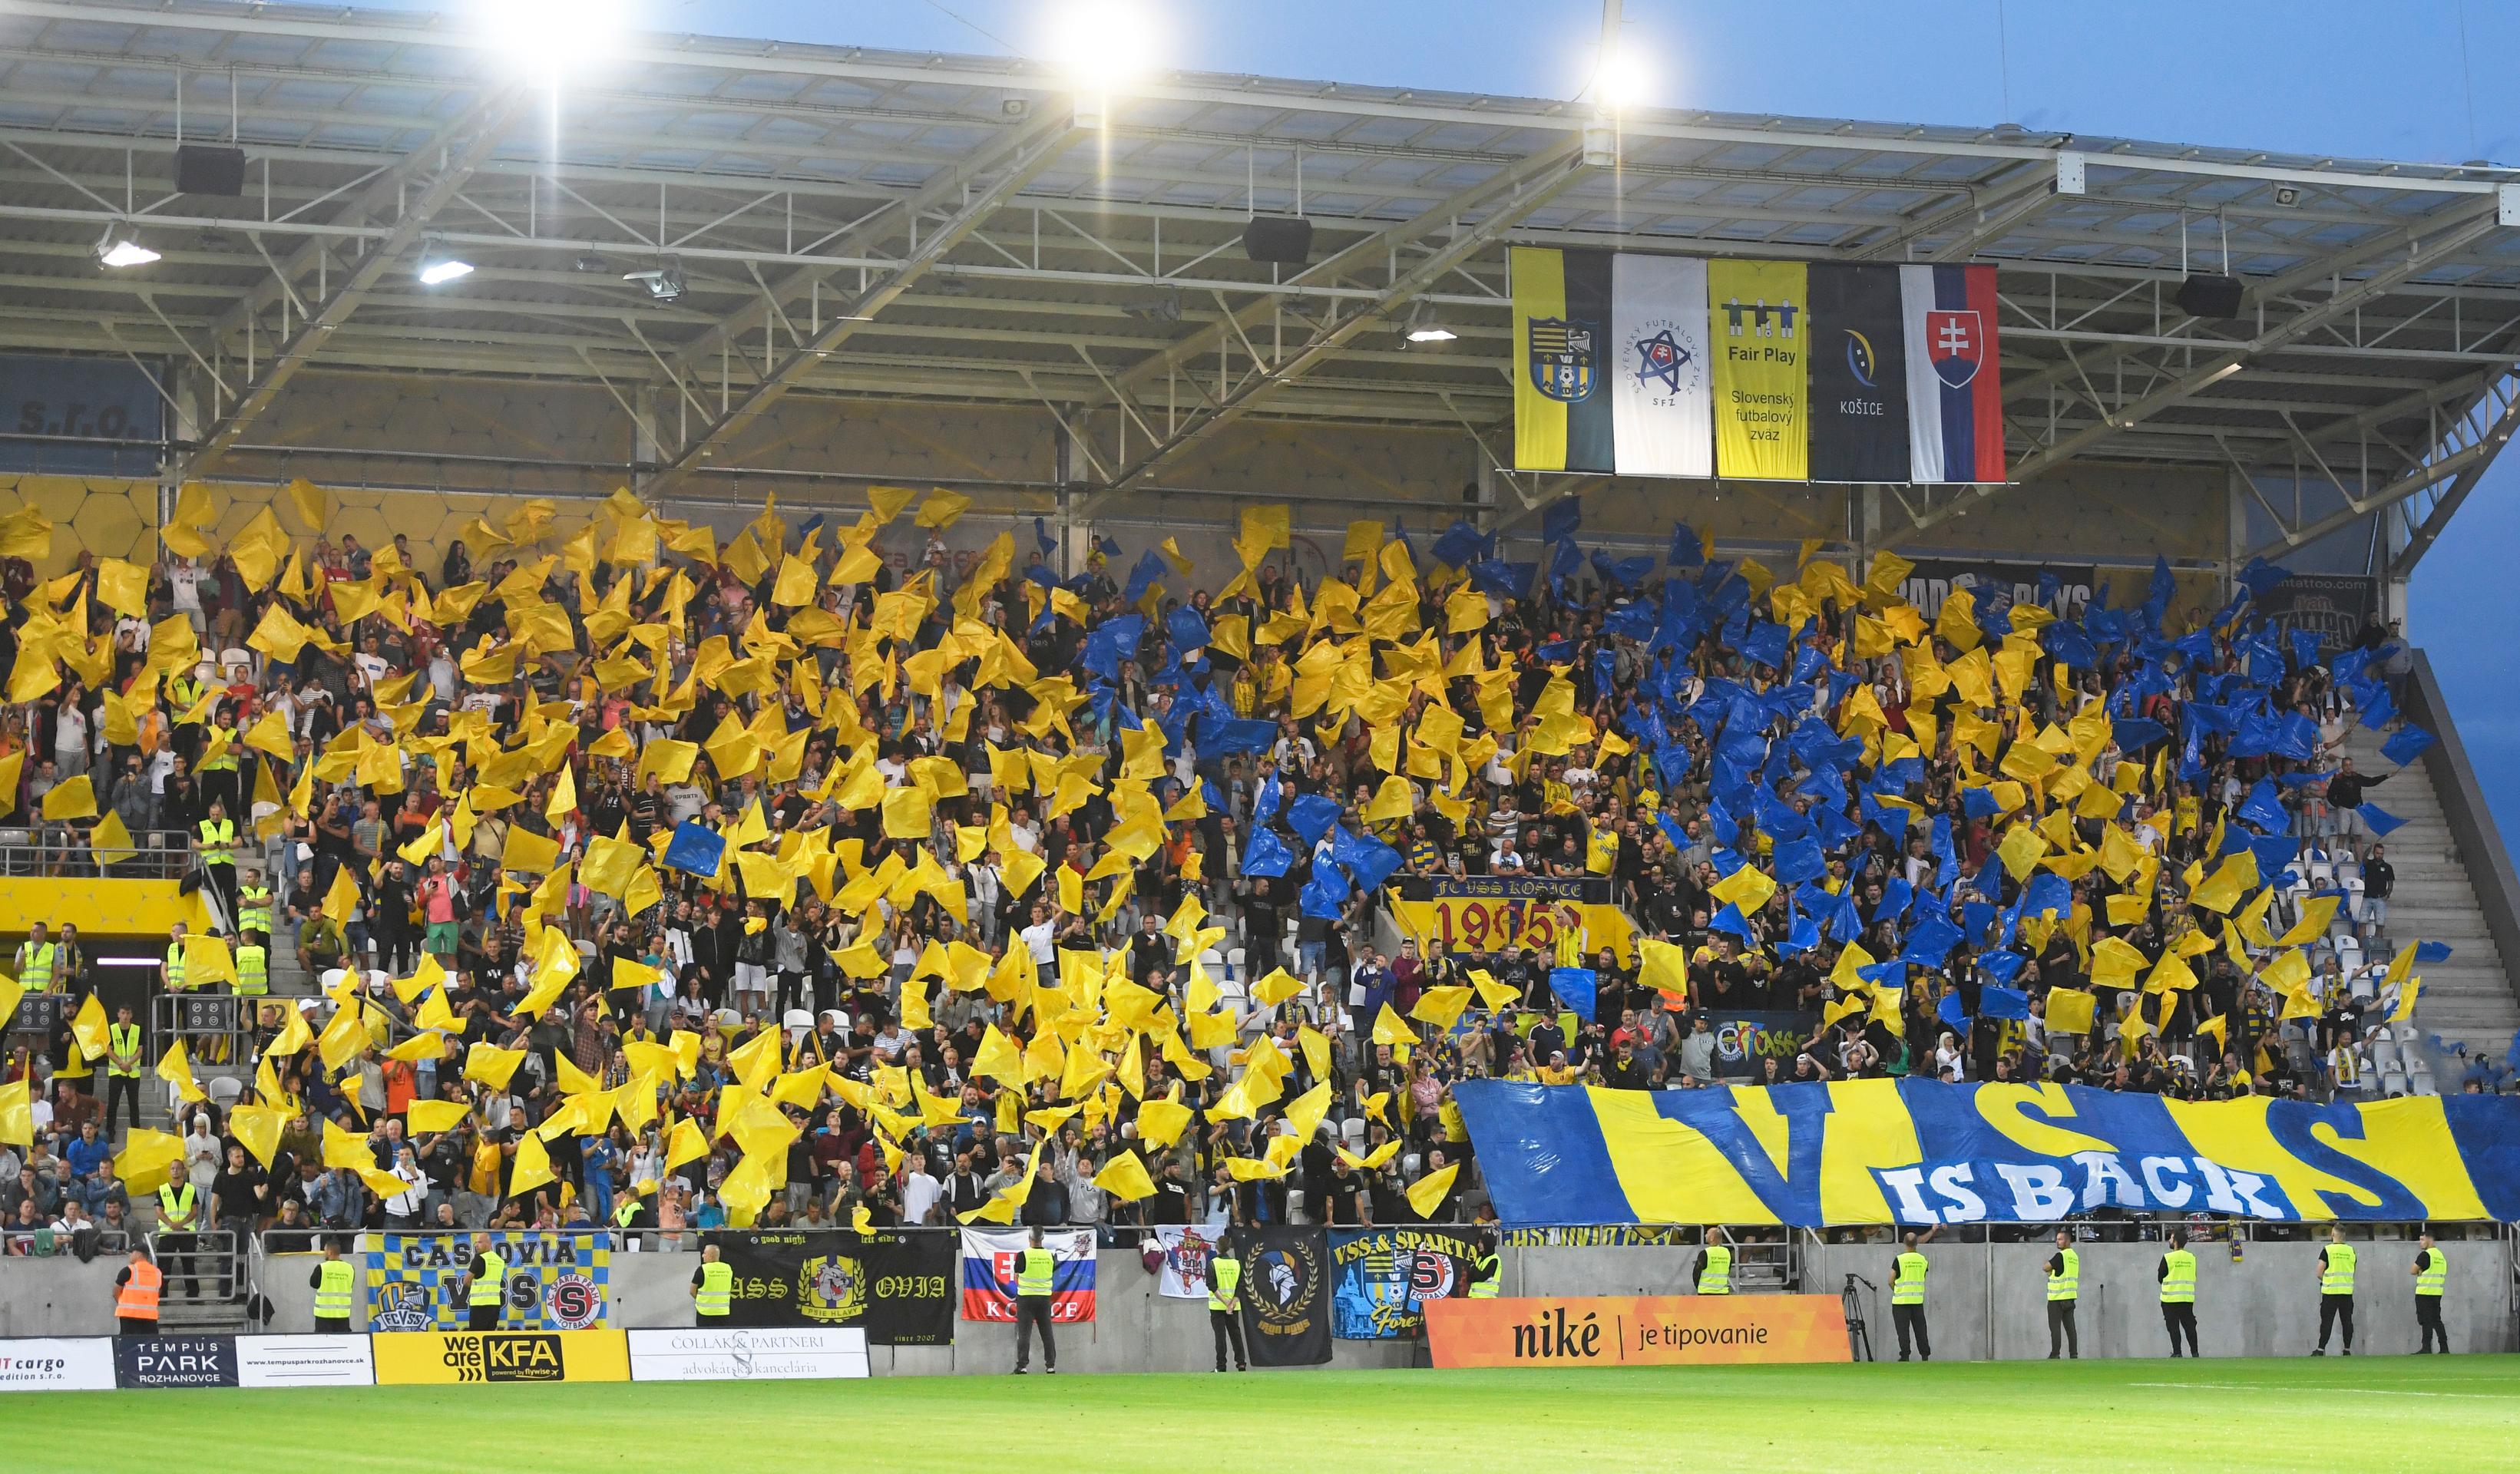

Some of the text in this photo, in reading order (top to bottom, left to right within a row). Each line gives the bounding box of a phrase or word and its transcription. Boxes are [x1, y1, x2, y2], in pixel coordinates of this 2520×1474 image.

[1728, 346, 1796, 366] Fair Play
[1652, 398, 1676, 407] SFZ
[1731, 390, 1794, 408] Slovenský
[1840, 398, 1884, 415] KOŠICE
[18, 401, 141, 439] s.r.o.
[1736, 409, 1793, 426] futbalový
[1750, 428, 1780, 441] zväz
[1436, 881, 1460, 896] FC
[1880, 1151, 2285, 1224] IS BACK
[760, 1234, 806, 1245] good night
[404, 1240, 576, 1267] CASOVIA
[1333, 1231, 1478, 1266] VSS & SPARTA
[442, 1272, 538, 1312] VS
[547, 1274, 600, 1307] AC SPARTA PRAHA
[729, 1277, 789, 1300] ASS
[808, 1307, 858, 1317] PSIE HLAVY
[986, 1300, 1078, 1318] KOCE
[557, 1319, 588, 1329] FOTBAL
[1512, 1307, 1768, 1357] niké je tipovanie
[137, 1343, 219, 1353] TEMPUS
[443, 1336, 480, 1351] we
[671, 1335, 825, 1350] ČOLLÁK & PARTNERI
[443, 1351, 481, 1367] are
[488, 1340, 558, 1367] KFA
[16, 1357, 65, 1372] cargo
[137, 1355, 219, 1372] PARK
[246, 1357, 365, 1367] www.tempusparkrozhanovce.sk
[683, 1360, 818, 1375] advokátska kancelária
[39, 1372, 66, 1381] s.r.o.
[139, 1373, 221, 1383] ROZHANOVCE
[524, 1368, 551, 1377] flywise
